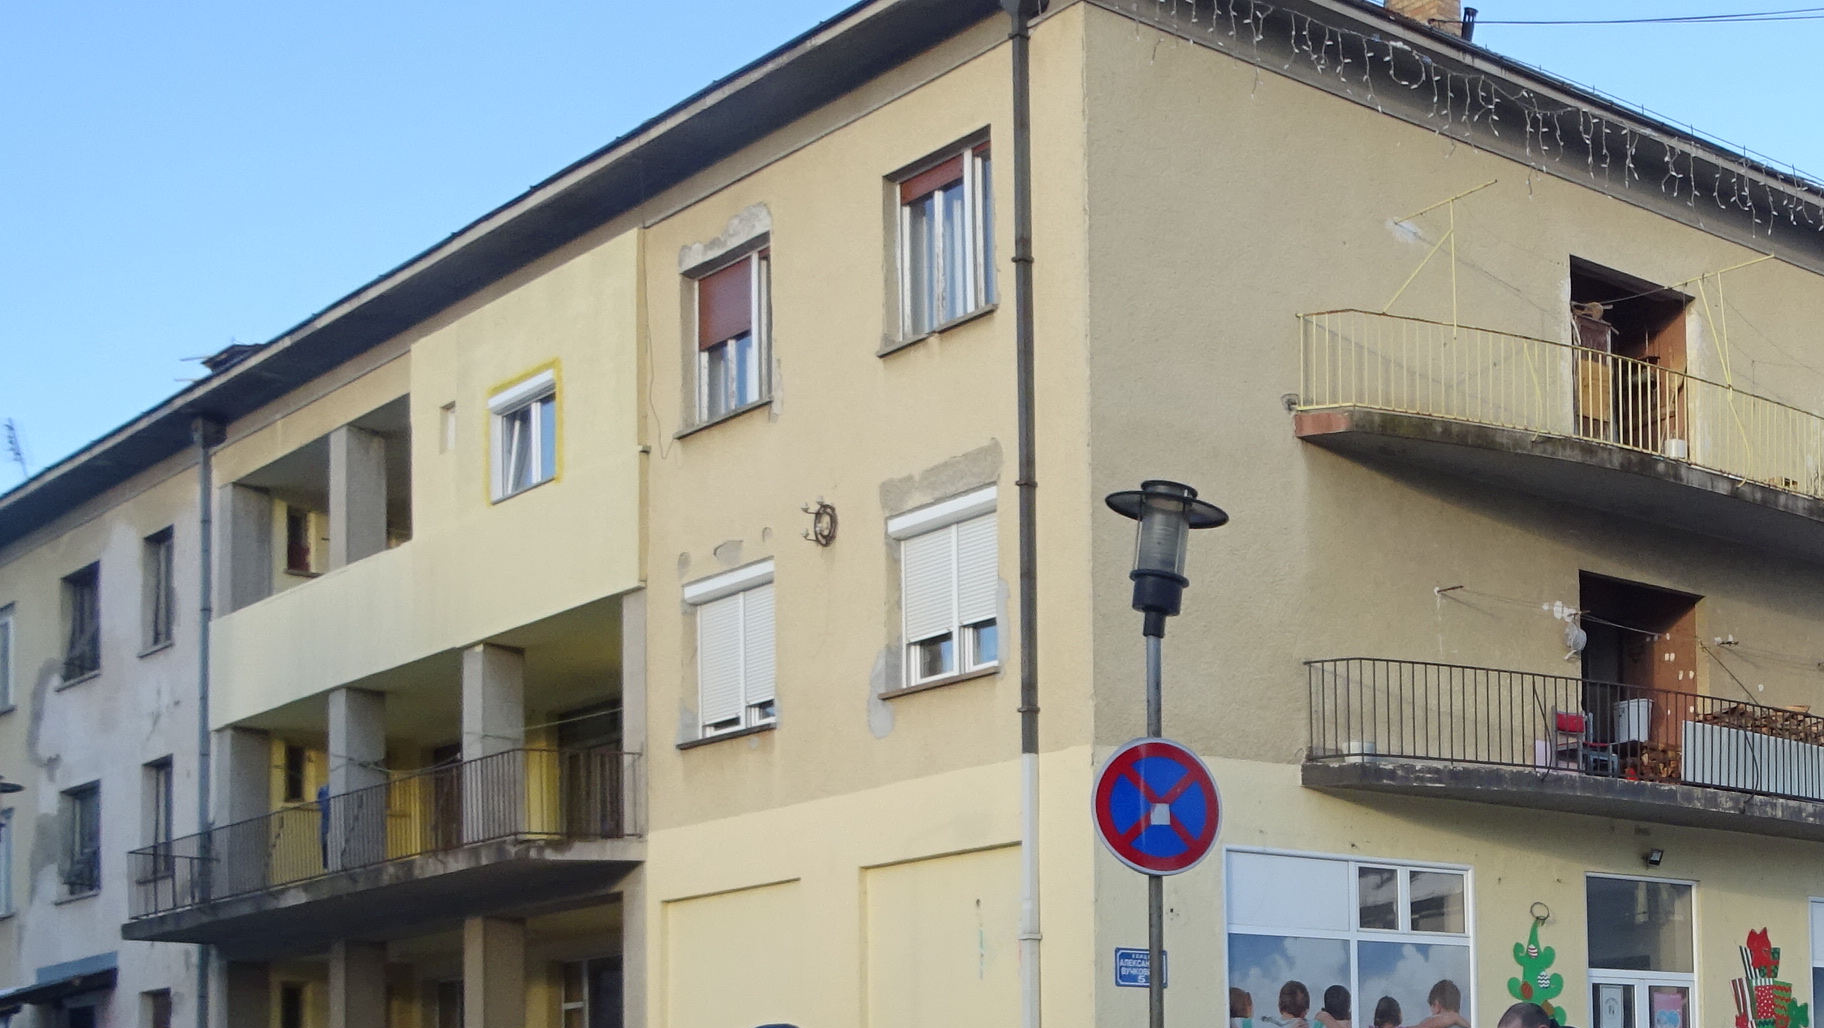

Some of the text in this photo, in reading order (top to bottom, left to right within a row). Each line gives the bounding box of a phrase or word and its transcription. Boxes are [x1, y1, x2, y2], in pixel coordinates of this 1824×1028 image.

[1120, 959, 1150, 967] АЛЕКСАН
[1121, 967, 1150, 975] ВУЧКОВ
[1137, 975, 1146, 983] 5
